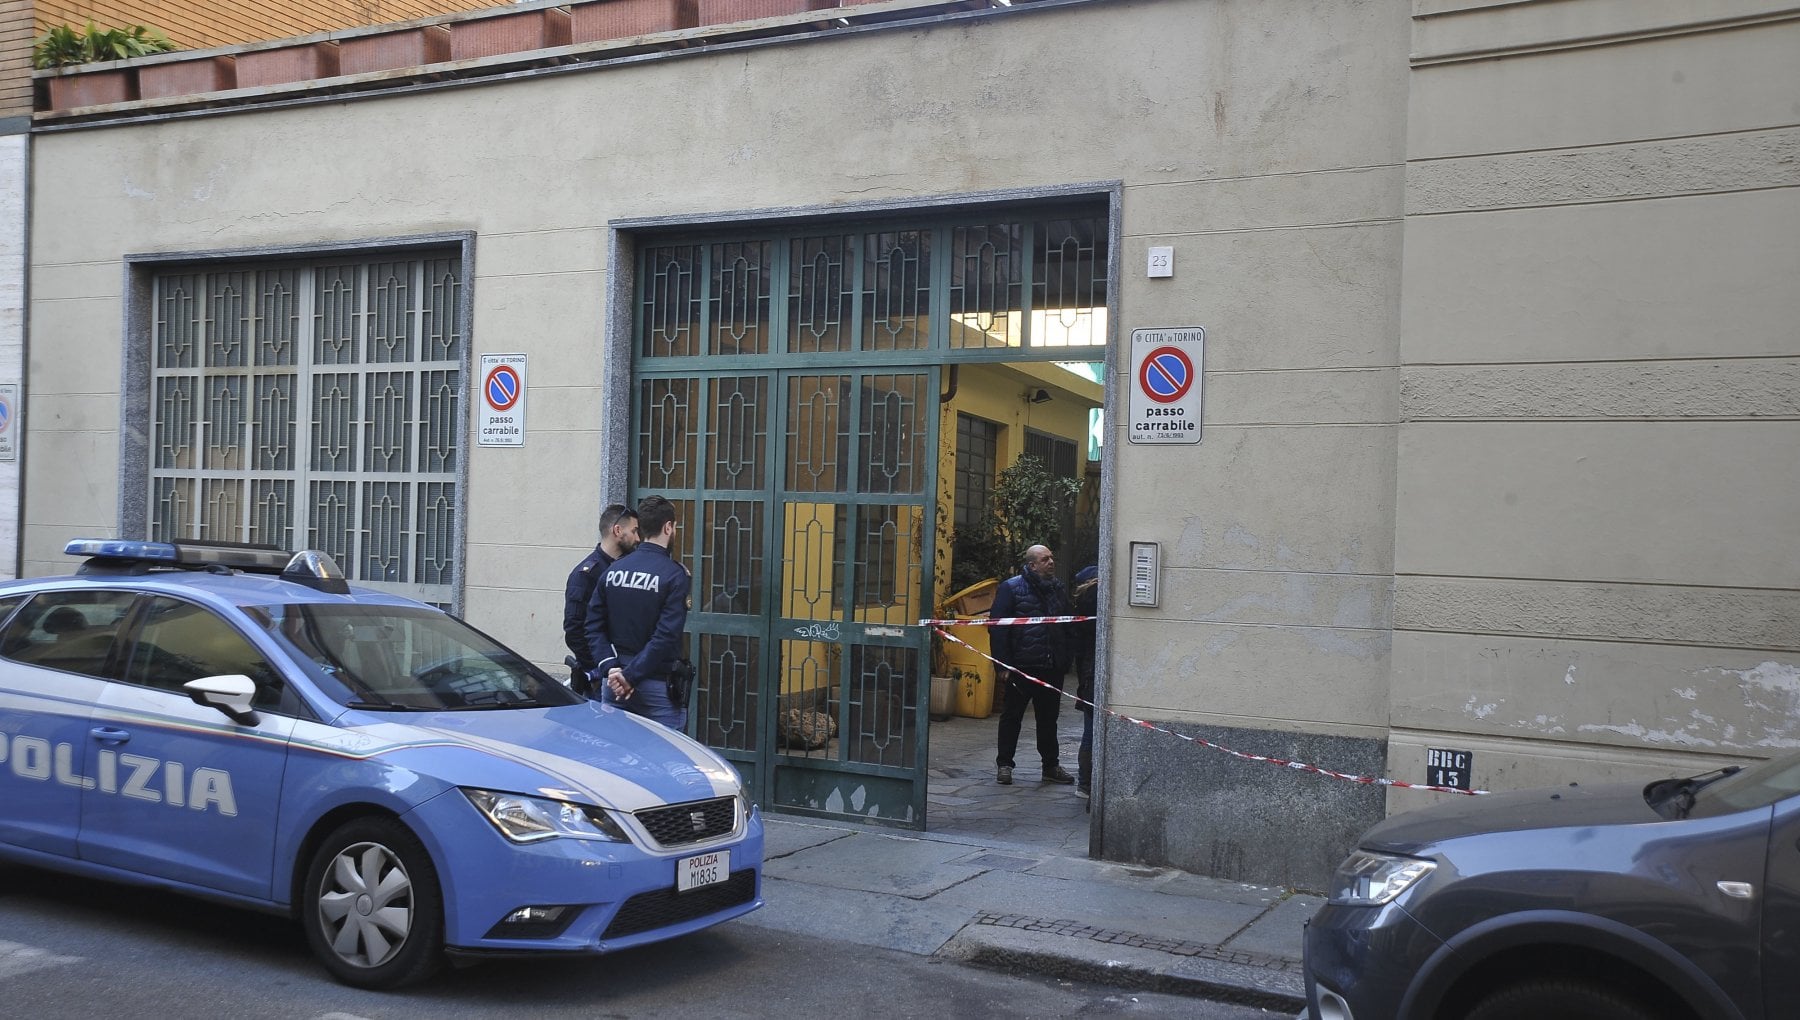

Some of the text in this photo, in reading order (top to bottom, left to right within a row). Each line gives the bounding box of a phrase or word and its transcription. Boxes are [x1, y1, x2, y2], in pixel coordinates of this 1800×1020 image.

[1152, 255, 1168, 267] 23
[1145, 332, 1167, 343] CITTA'
[1174, 331, 1202, 343] TORINO
[1146, 407, 1185, 418] passo
[489, 416, 514, 425] passo
[1135, 419, 1195, 431] carrabile
[482, 426, 519, 435] carrabile
[605, 570, 660, 593] POLIZIA
[0, 731, 238, 817] OLIZIA
[690, 853, 718, 869] POLIZIA
[690, 866, 718, 888] M1835
